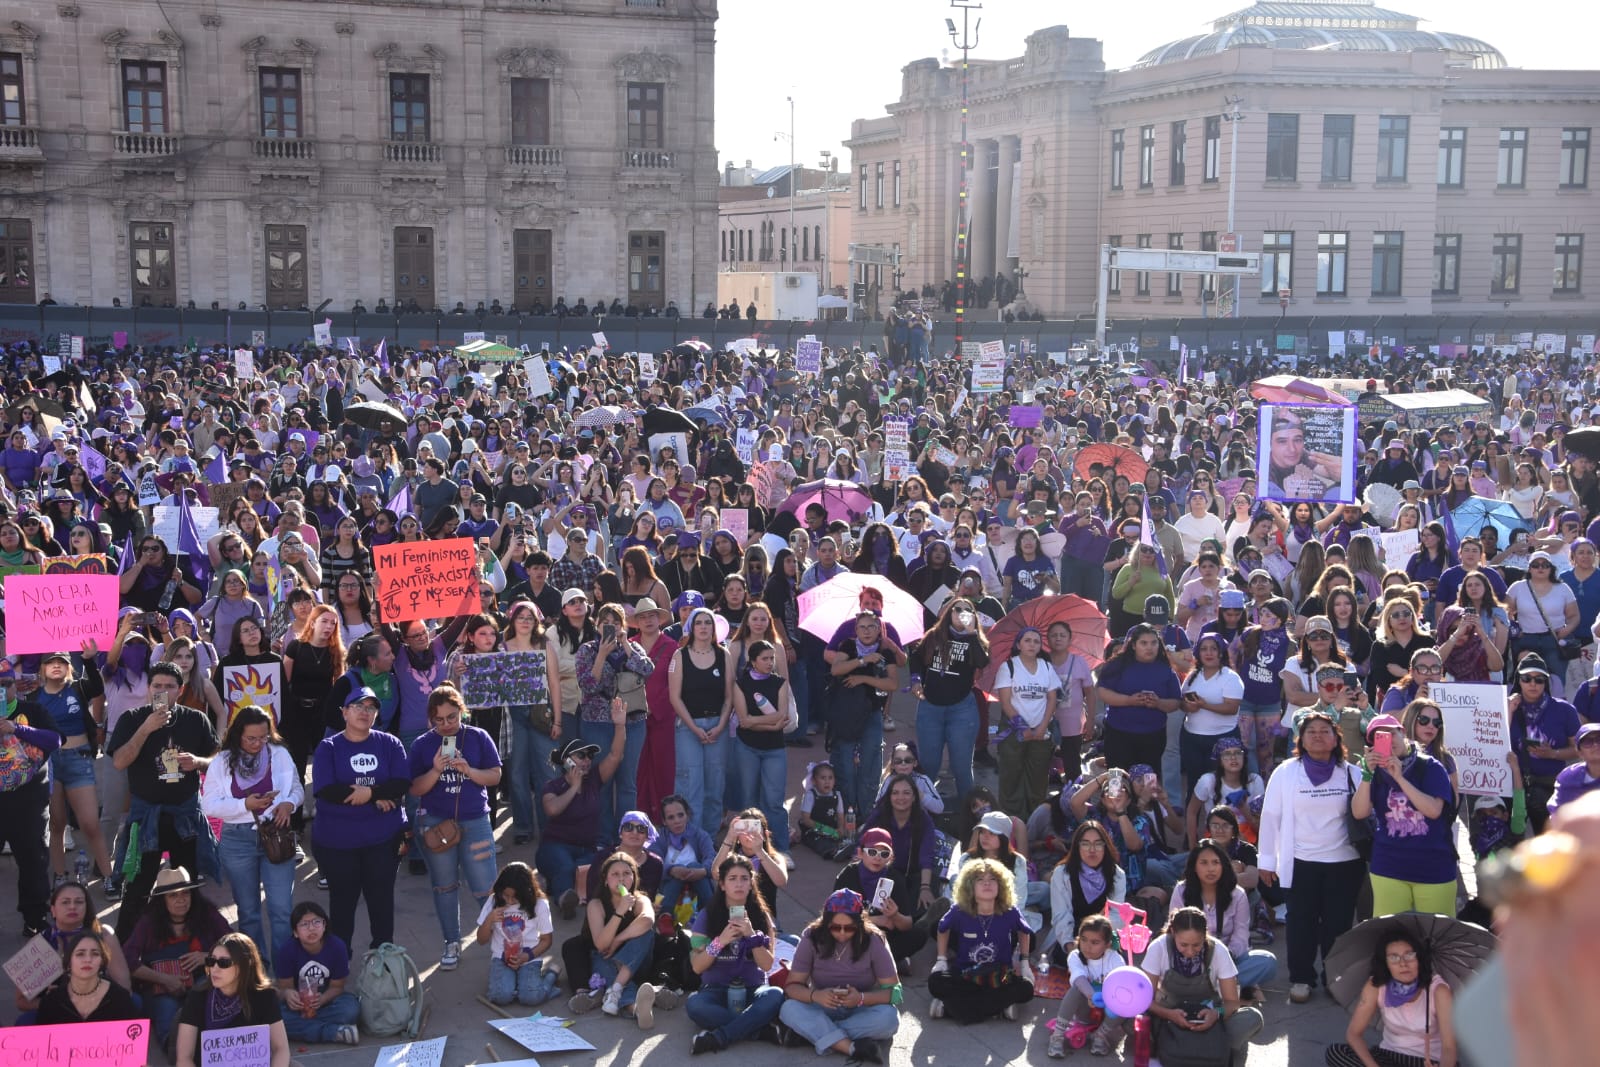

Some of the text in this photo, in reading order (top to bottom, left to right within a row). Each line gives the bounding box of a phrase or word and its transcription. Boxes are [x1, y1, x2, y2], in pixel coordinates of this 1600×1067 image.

[22, 583, 93, 606] NO ERA
[32, 600, 99, 623] AMOR ERA
[351, 757, 376, 766] #8M
[203, 1031, 258, 1051] QUE SER MUJER
[208, 1051, 223, 1064] SEA
